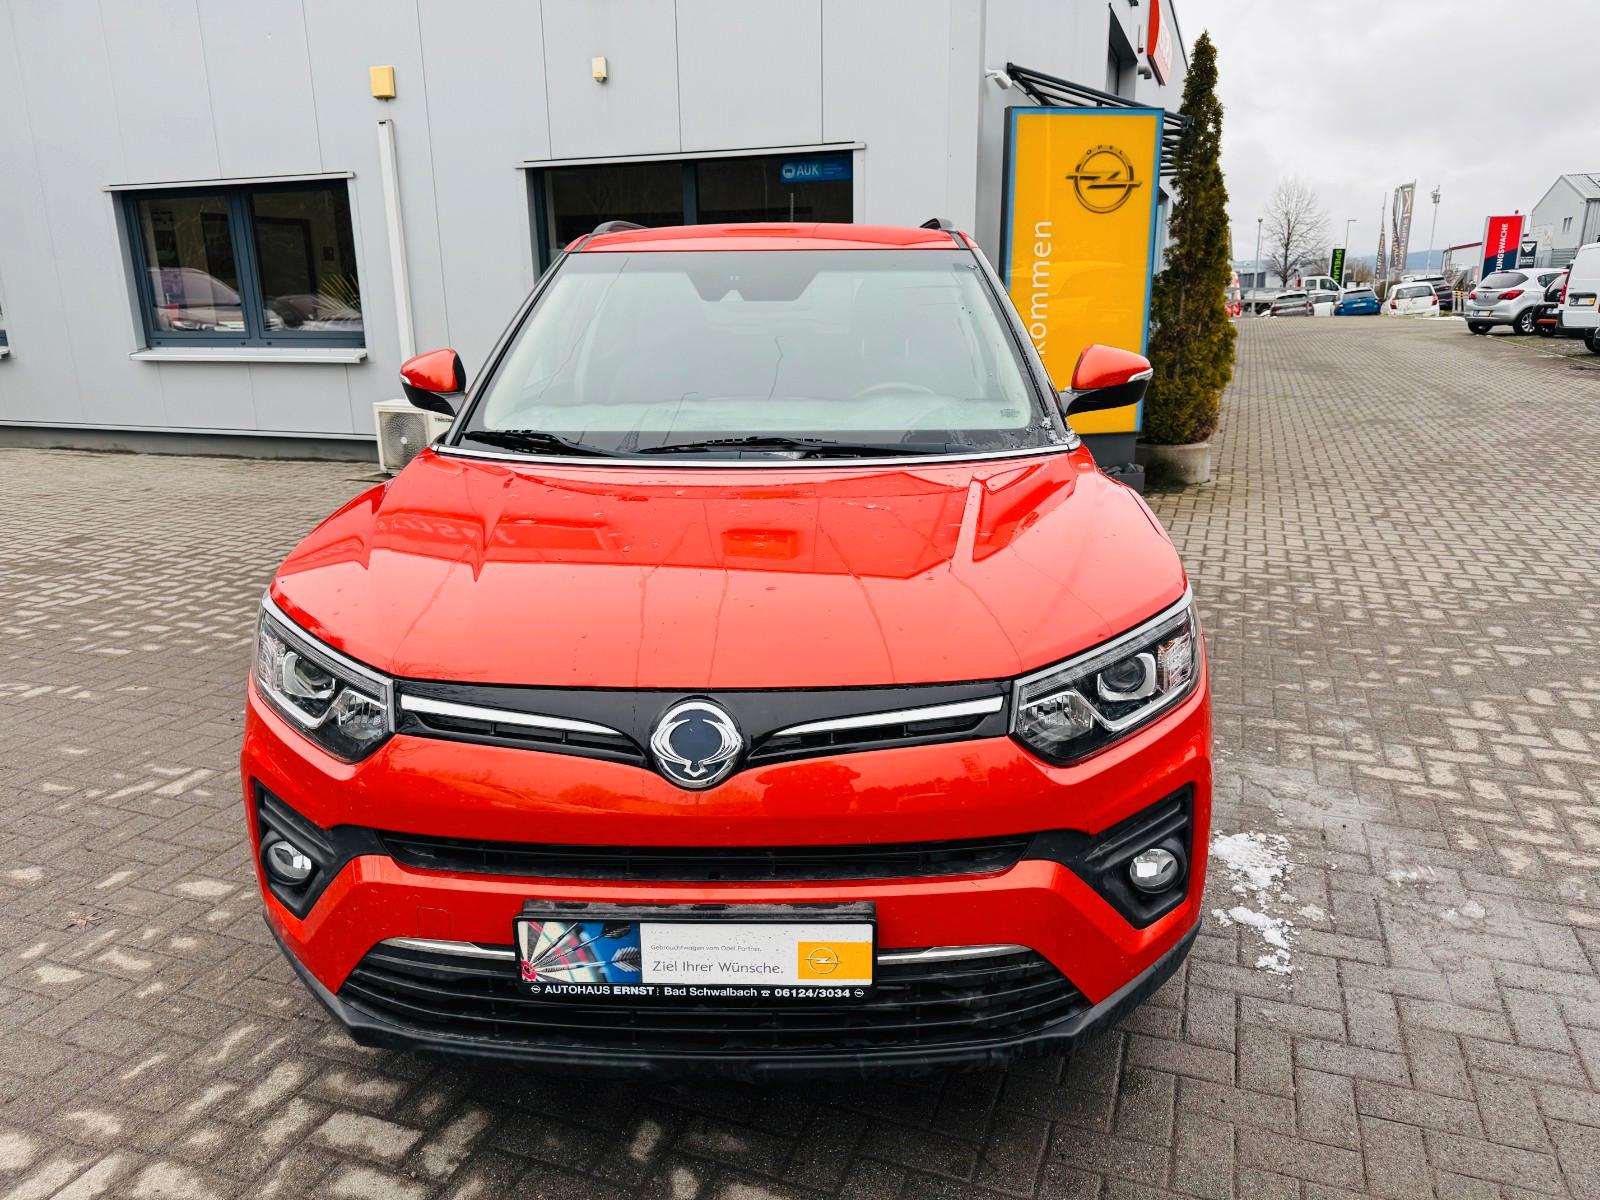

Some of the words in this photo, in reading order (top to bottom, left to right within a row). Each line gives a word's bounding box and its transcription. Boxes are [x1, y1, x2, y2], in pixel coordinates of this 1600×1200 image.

[652, 960, 678, 972] Ziel
[682, 961, 714, 972] Ihrer
[718, 961, 784, 974] Wünsche.
[544, 985, 610, 995] AUTOHAUS
[613, 986, 655, 996] ERNST
[664, 987, 686, 996] Bad
[689, 987, 758, 997] Schwalbach
[774, 988, 851, 998] 06124/3034
